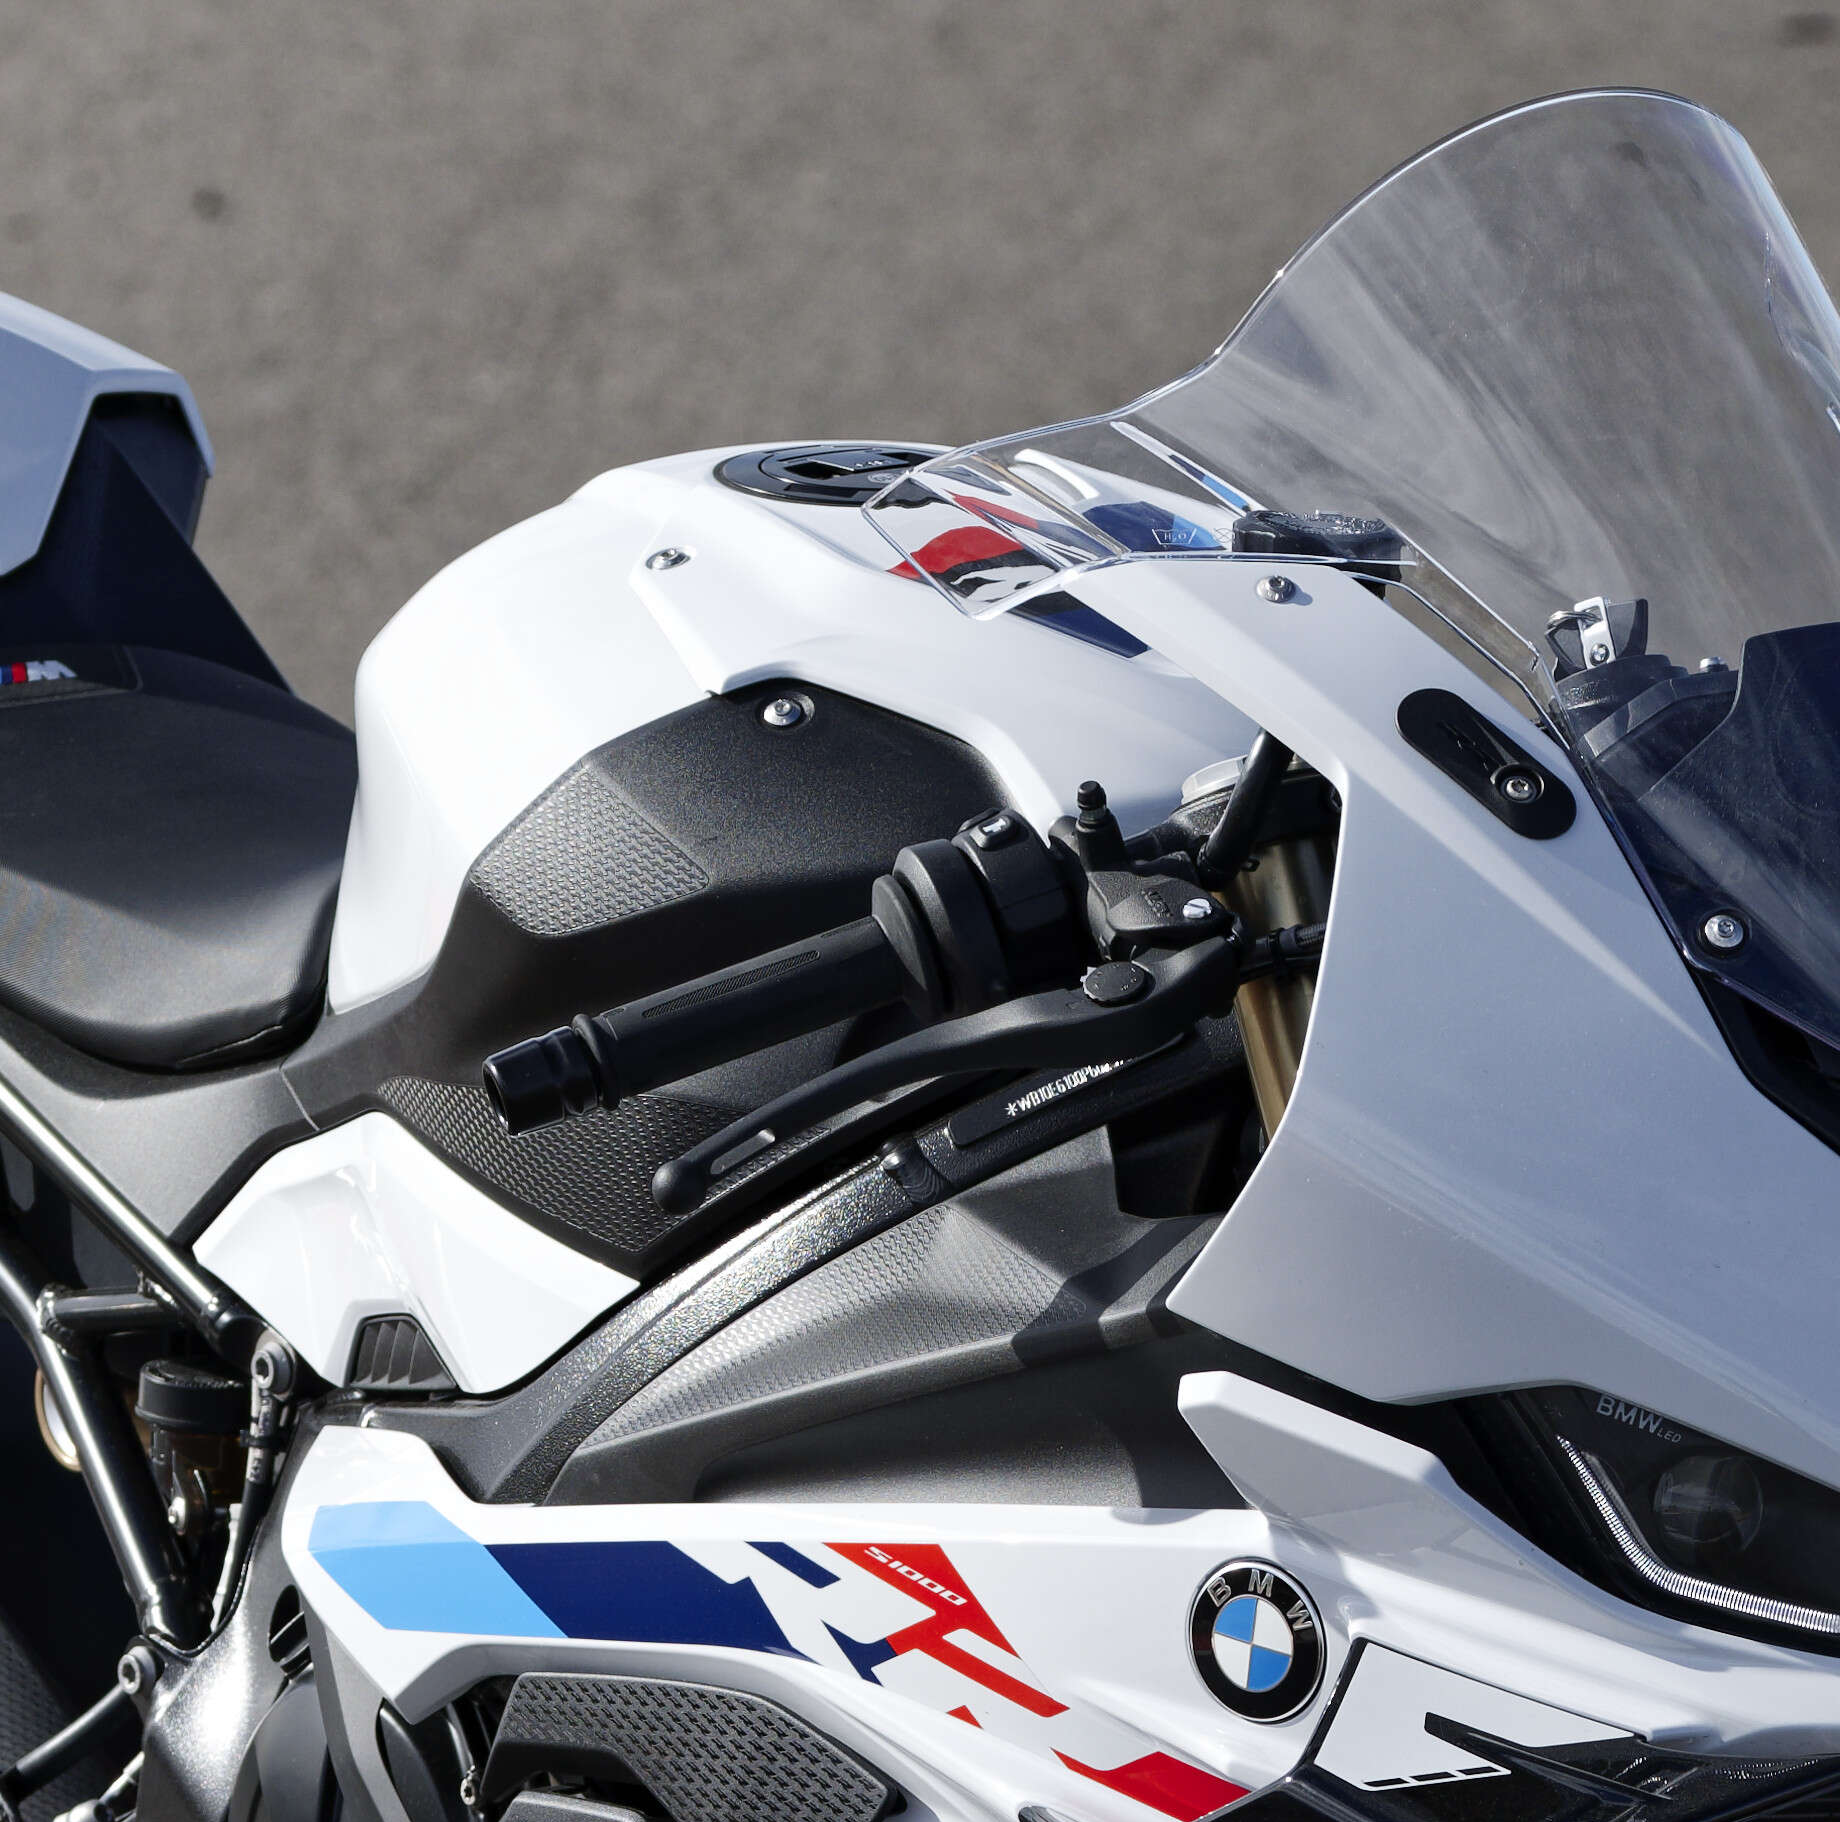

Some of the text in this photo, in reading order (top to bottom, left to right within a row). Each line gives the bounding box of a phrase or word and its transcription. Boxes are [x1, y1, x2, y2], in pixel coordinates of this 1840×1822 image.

[1596, 1394, 1682, 1444] BMW LED
[863, 1545, 969, 1607] S1000
[1206, 1568, 1313, 1632] BMW
